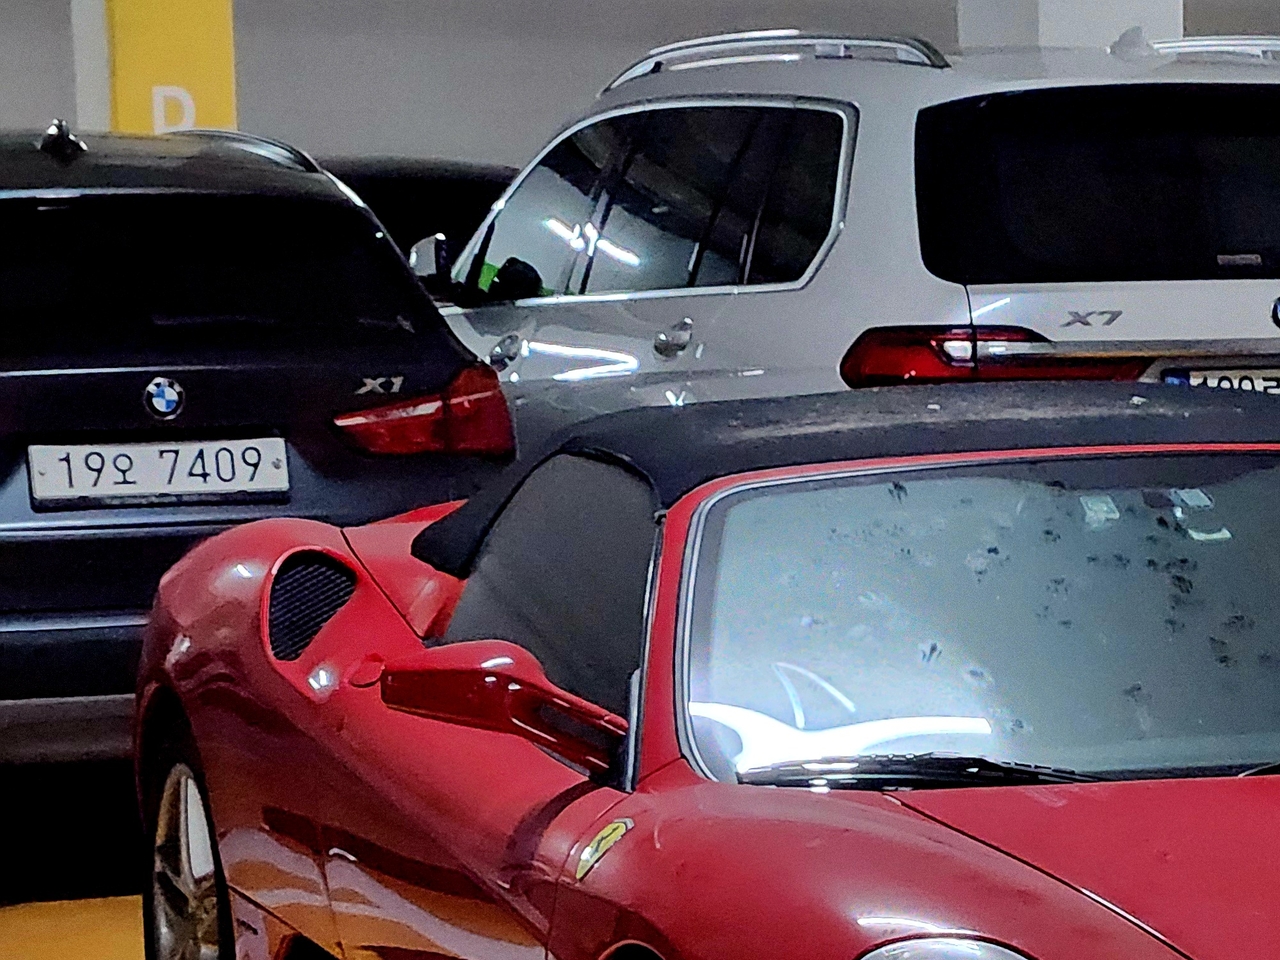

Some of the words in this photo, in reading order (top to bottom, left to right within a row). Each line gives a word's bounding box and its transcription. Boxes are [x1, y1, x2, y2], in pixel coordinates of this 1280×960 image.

[1060, 310, 1123, 327] X7
[355, 376, 404, 394] X1
[58, 451, 137, 489] 19오
[157, 446, 262, 485] 7409
